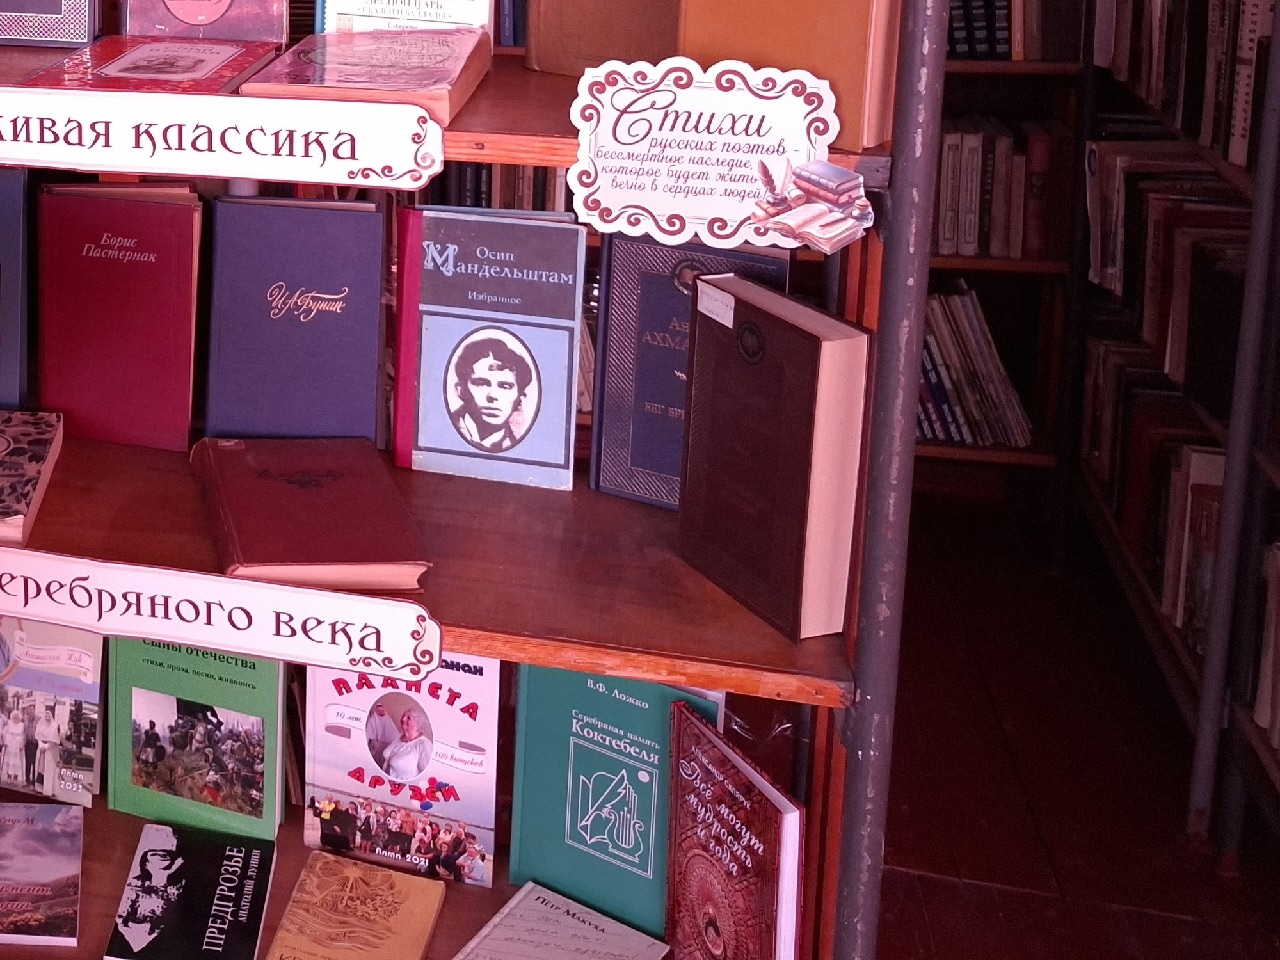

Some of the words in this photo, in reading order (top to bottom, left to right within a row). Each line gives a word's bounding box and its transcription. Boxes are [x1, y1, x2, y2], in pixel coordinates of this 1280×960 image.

[610, 87, 773, 146] Стихи
[131, 120, 359, 167] классика
[596, 145, 685, 166] бессмертное
[688, 156, 753, 171] наследие,
[648, 136, 717, 155] русских
[721, 138, 787, 157] поэтов
[601, 165, 662, 179] которое
[667, 164, 711, 184] будет
[715, 172, 758, 184] жить
[611, 178, 648, 192] вечно
[651, 179, 658, 191] в
[662, 183, 716, 200] сердцах
[719, 187, 770, 202] людей!
[82, 244, 158, 263] Пастернак
[101, 233, 138, 249] Борис
[476, 246, 514, 261] Осип
[422, 240, 574, 284] Мандельштам
[468, 290, 522, 304] Избранное
[272, 611, 384, 657] века
[186, 646, 257, 670] отечества
[587, 678, 608, 694] В.Ф.
[612, 688, 649, 709] Ложко
[572, 709, 624, 736] Серебряная
[572, 718, 659, 765] Коктебеля
[686, 793, 752, 868] мудрость
[716, 803, 764, 856] могут
[709, 839, 738, 877] года
[202, 846, 245, 952] ПРЕДГРОЗЬЕ
[238, 879, 256, 923] АНАТОЛИЙ
